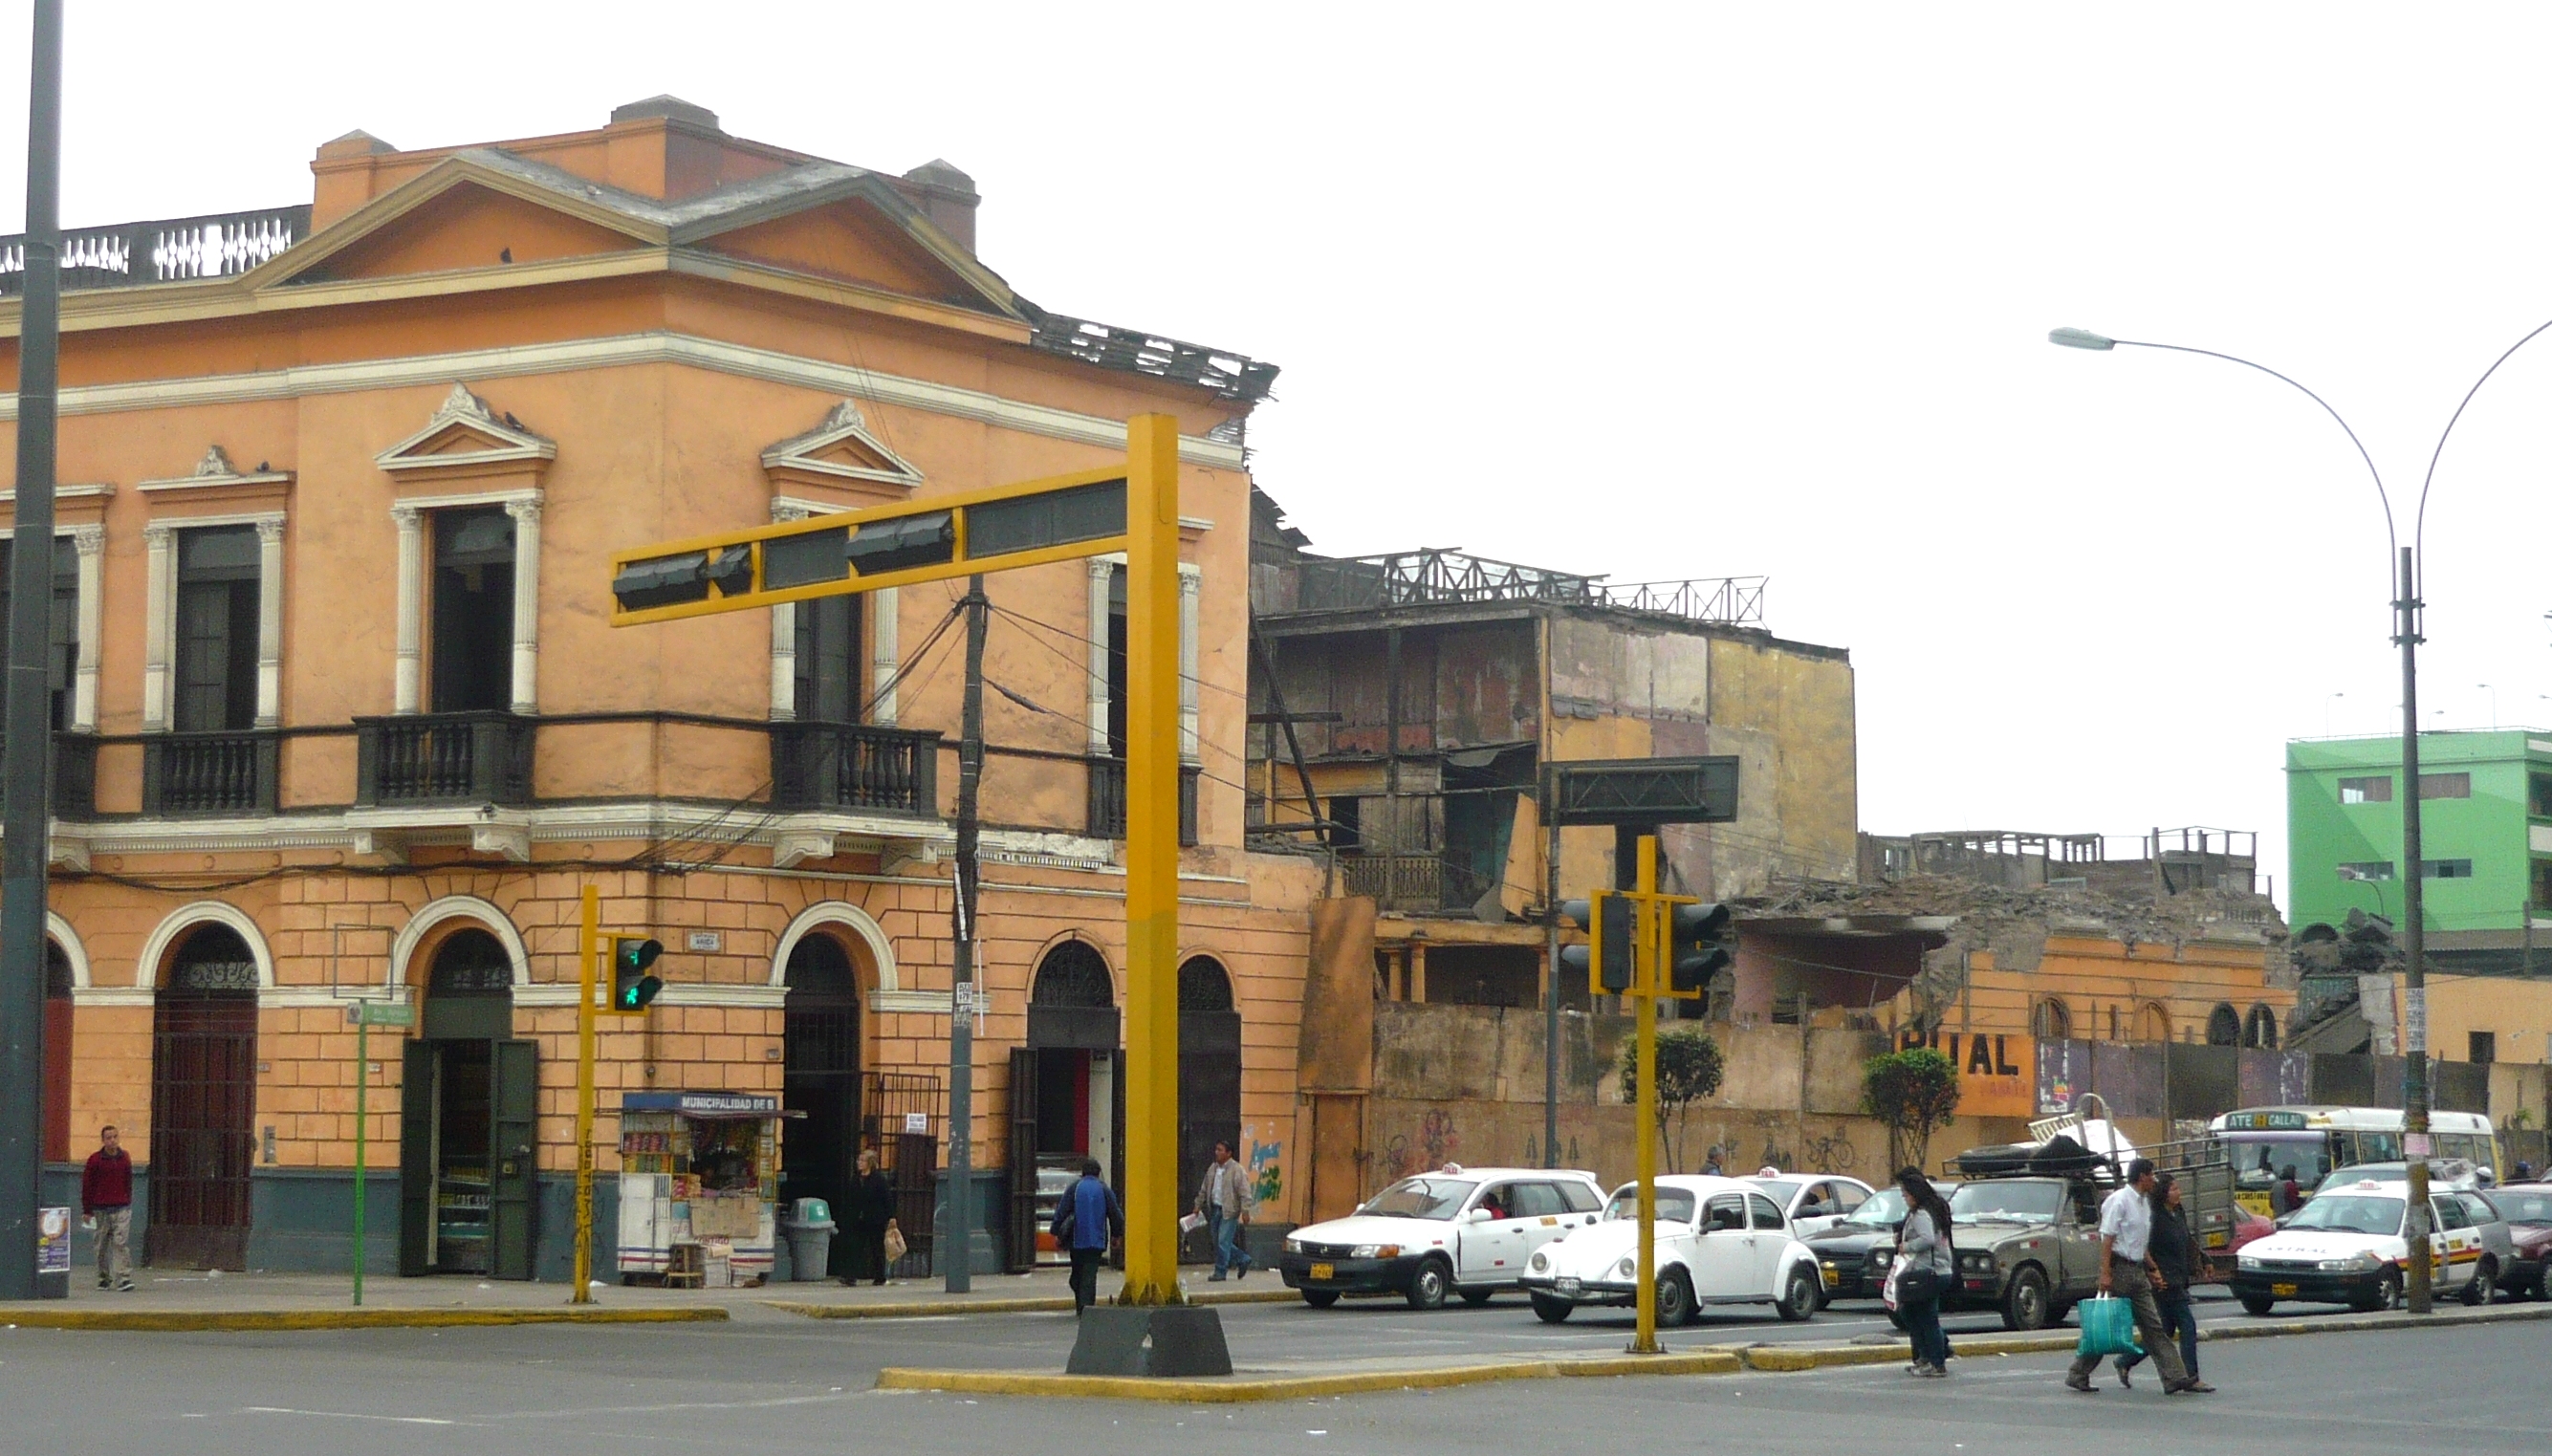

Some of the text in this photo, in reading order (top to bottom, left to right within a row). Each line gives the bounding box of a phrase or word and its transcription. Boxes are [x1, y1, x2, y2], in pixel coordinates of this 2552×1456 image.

[682, 1096, 774, 1110] MUNICIPALIDAD DE B
[2229, 1114, 2252, 1127] ATE
[2268, 1114, 2301, 1126] CALLAO
[1444, 1166, 1458, 1175] TAXI
